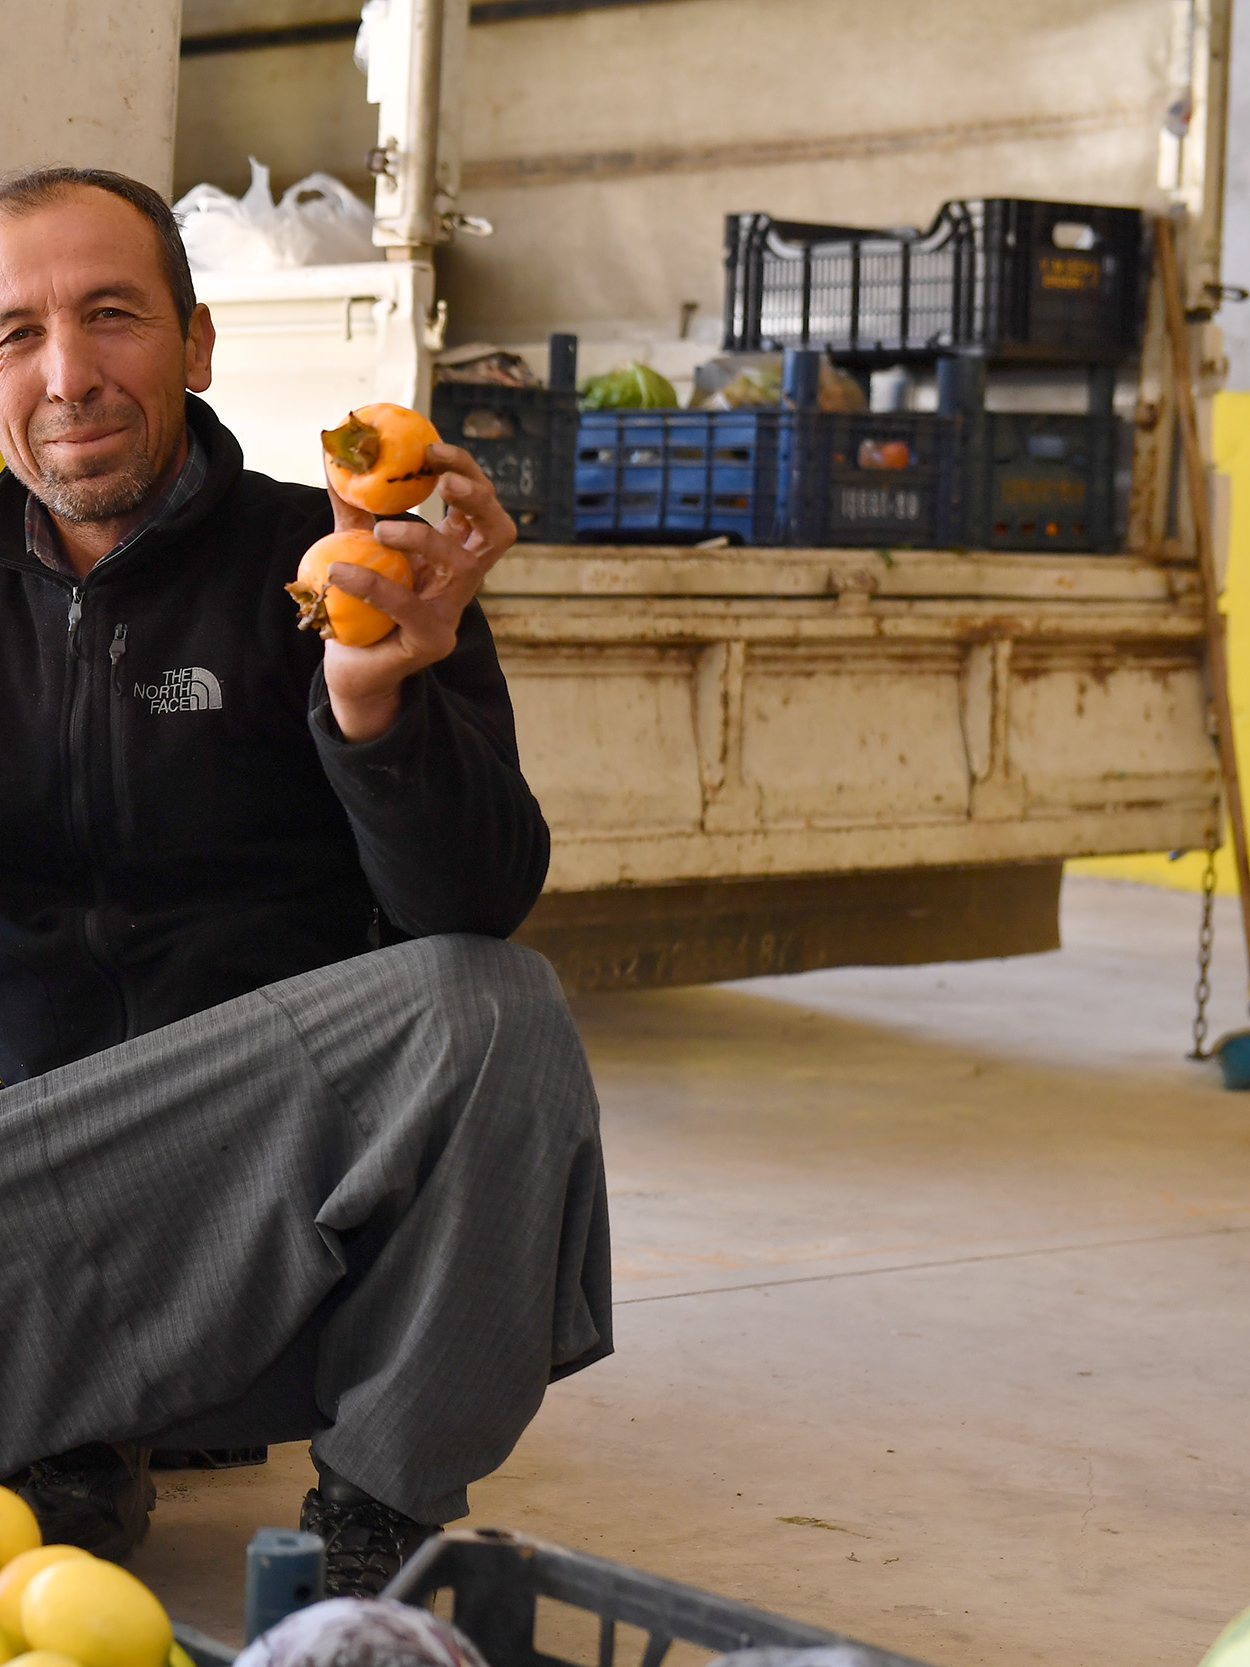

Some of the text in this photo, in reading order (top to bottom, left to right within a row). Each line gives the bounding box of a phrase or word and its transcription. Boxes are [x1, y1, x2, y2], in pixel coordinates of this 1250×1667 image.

[162, 667, 192, 685] THE
[133, 681, 191, 699] NORTH
[150, 696, 190, 714] FACE
